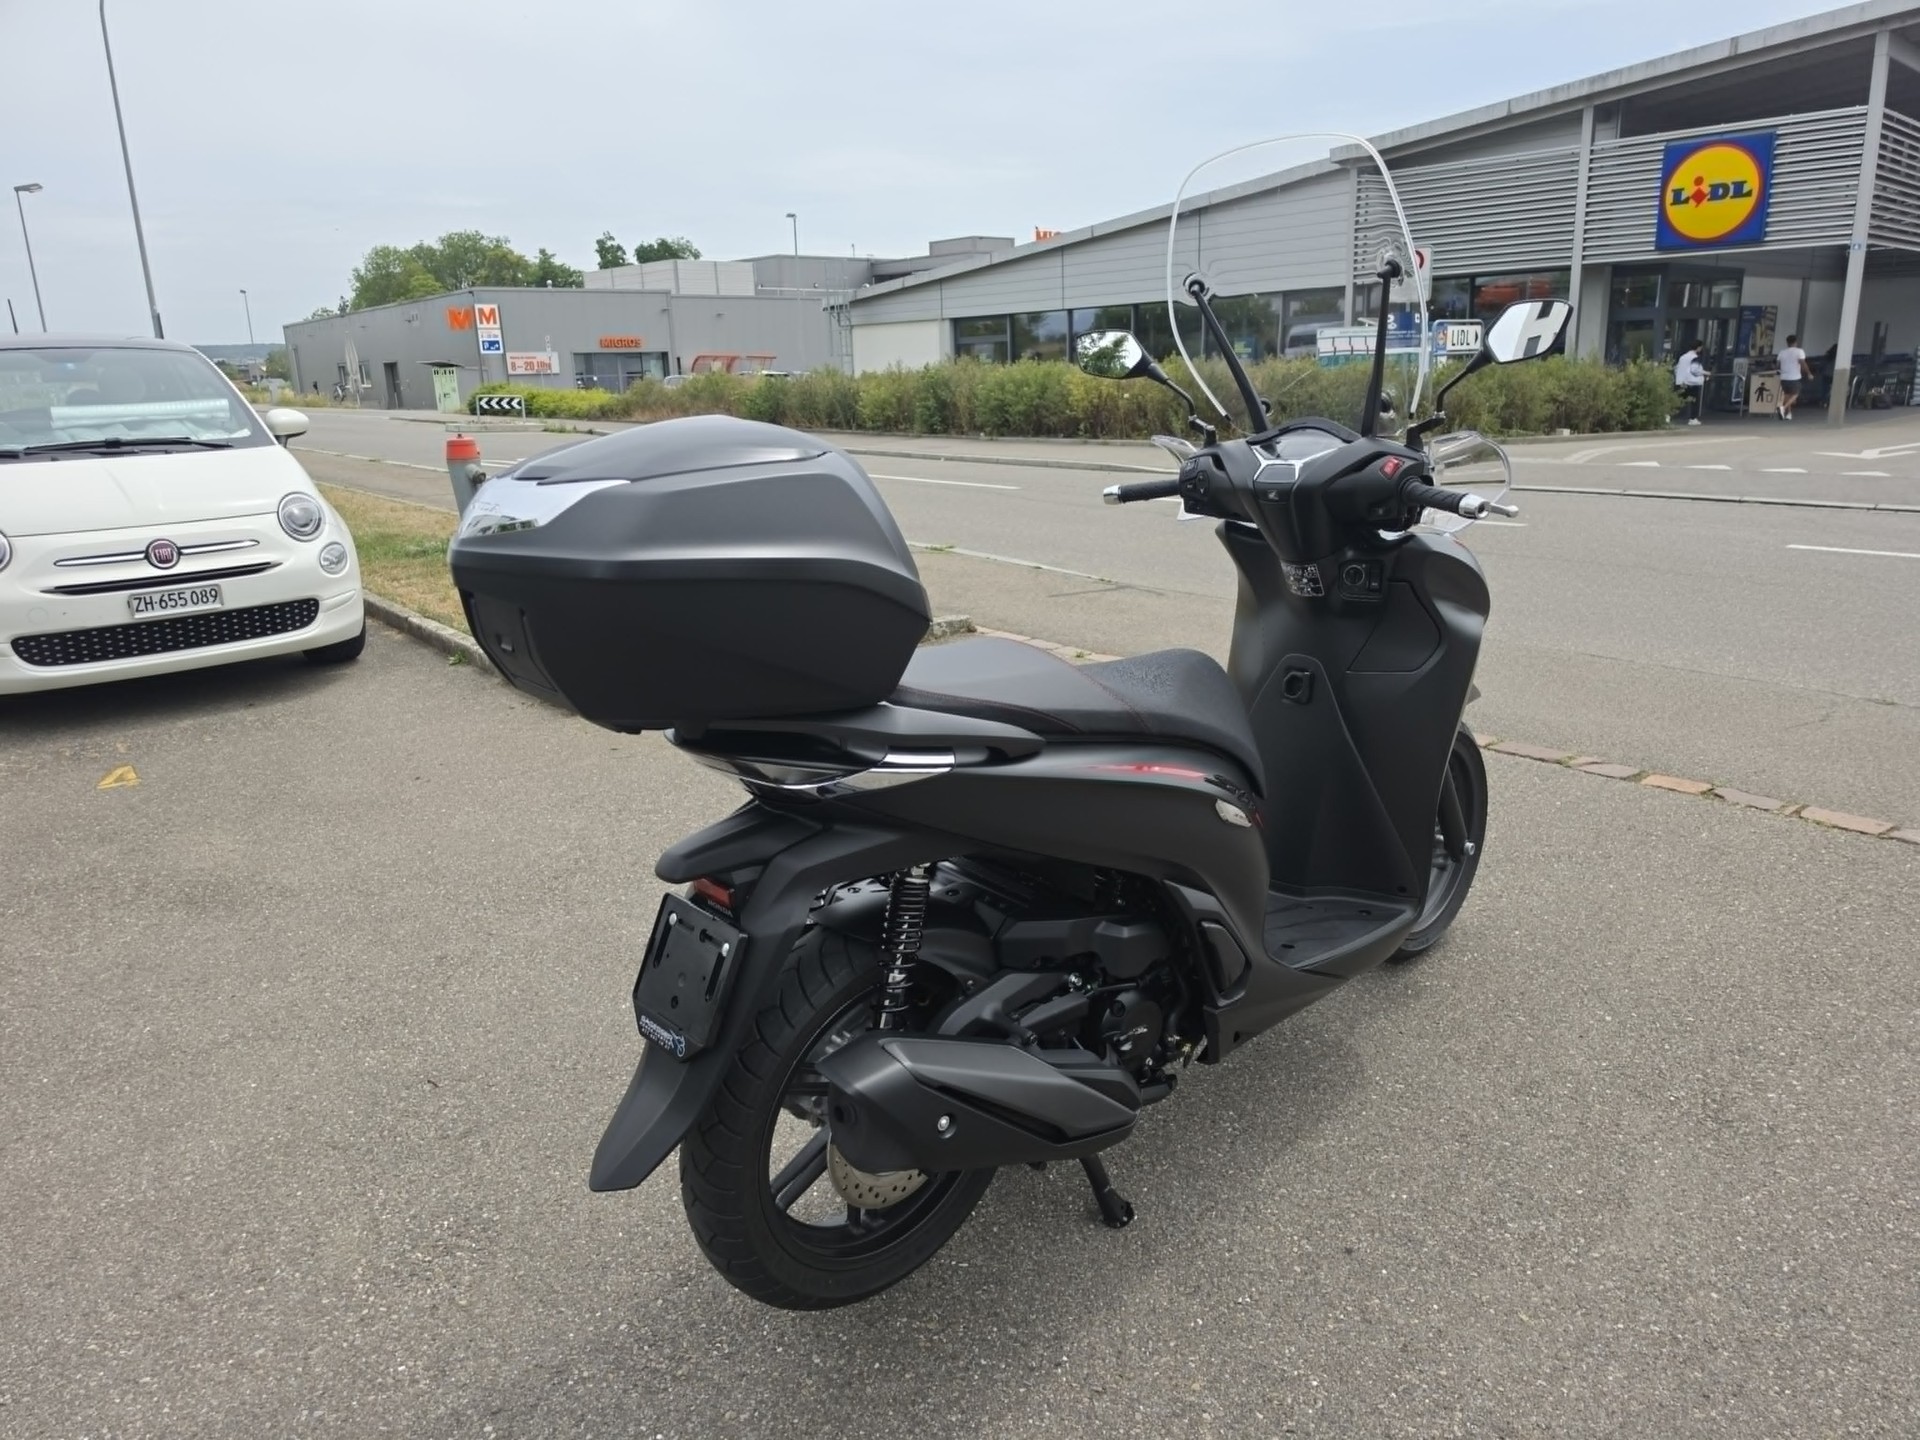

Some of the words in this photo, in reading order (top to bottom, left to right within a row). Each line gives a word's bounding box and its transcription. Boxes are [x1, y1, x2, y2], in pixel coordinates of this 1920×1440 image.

[447, 307, 474, 330] M
[478, 307, 498, 325] M
[600, 337, 642, 348] MIGROS
[1451, 328, 1470, 347] LIDL
[155, 548, 173, 561] FIAT
